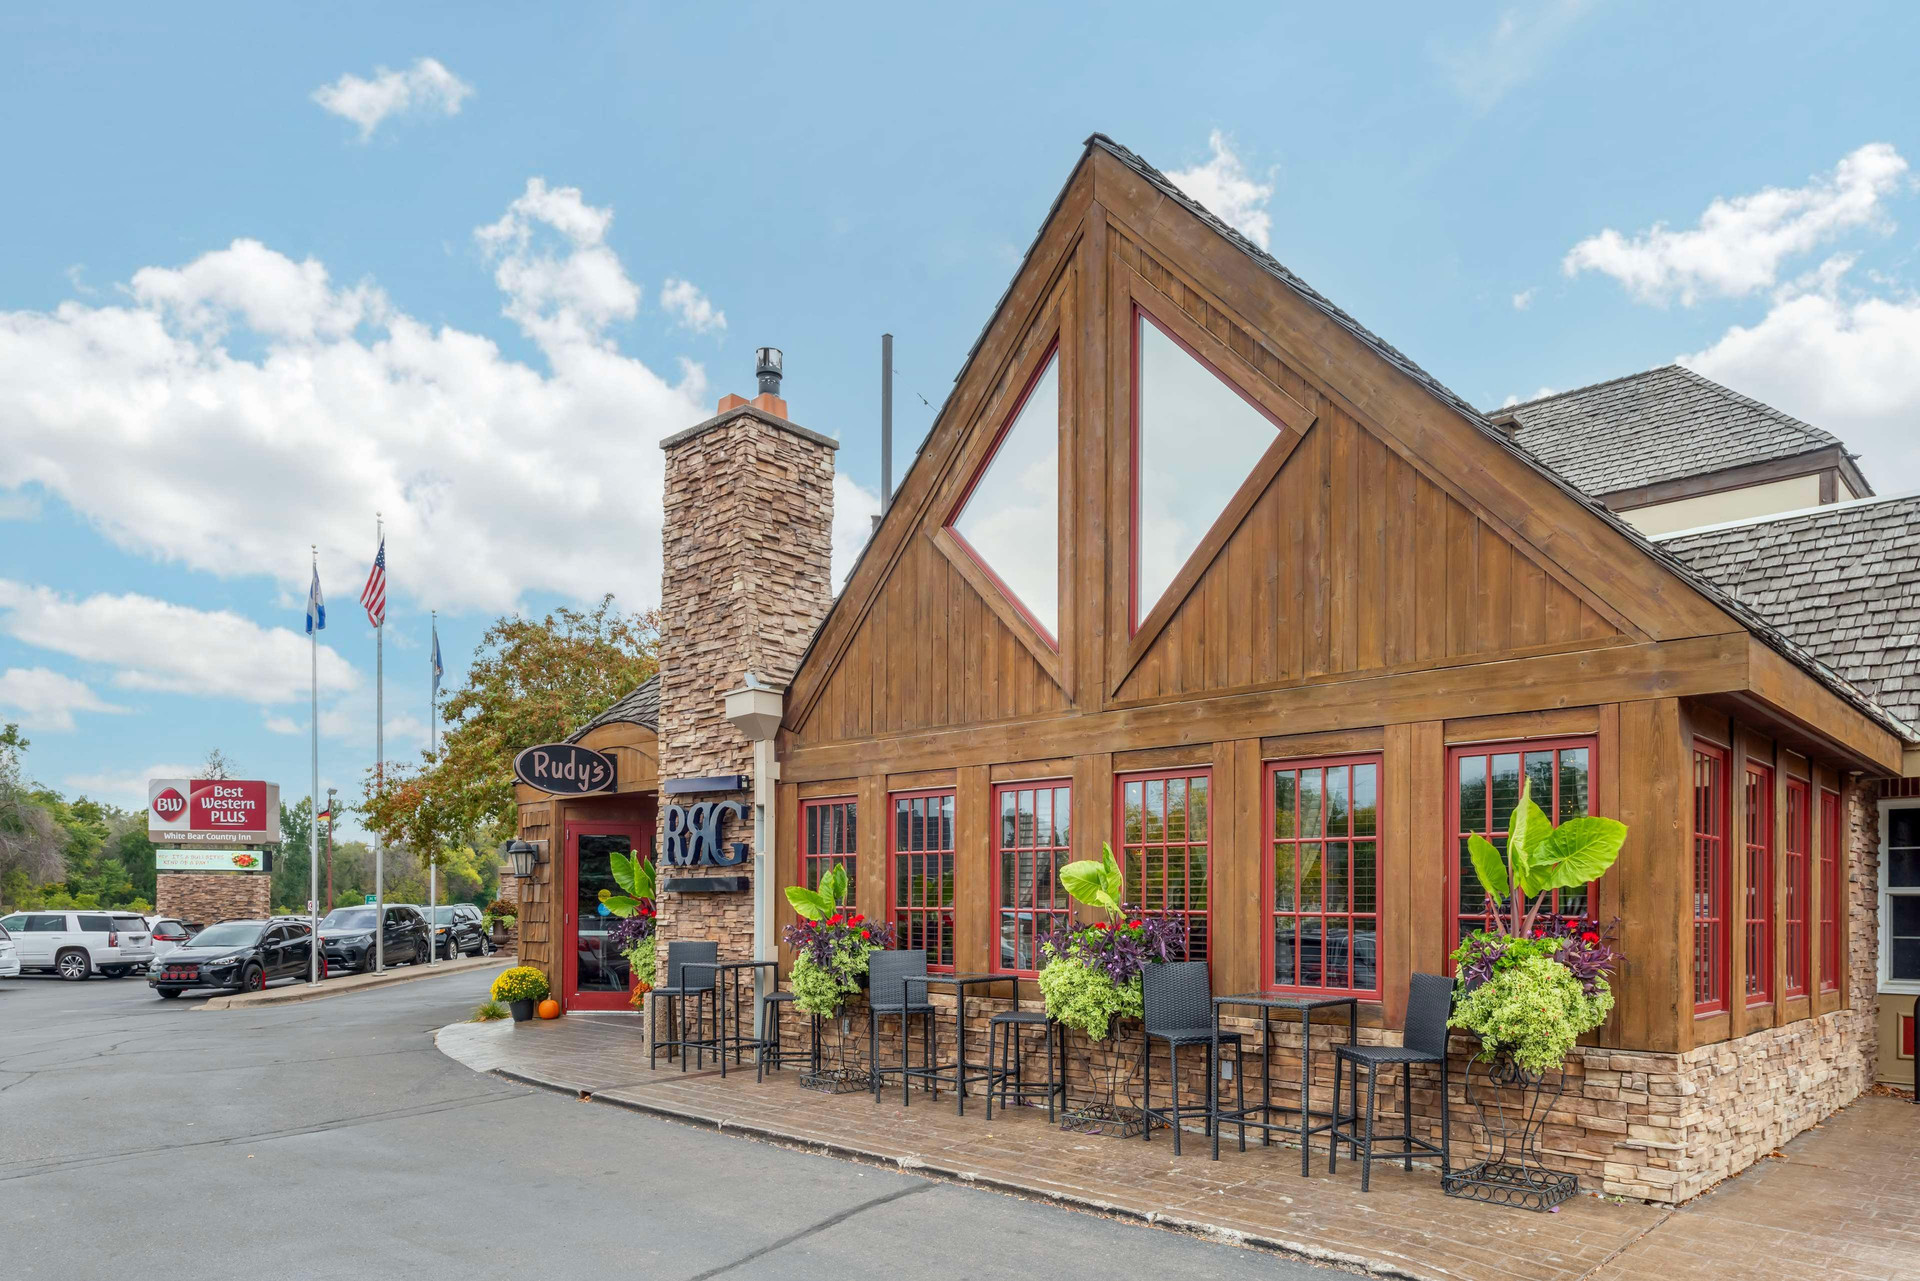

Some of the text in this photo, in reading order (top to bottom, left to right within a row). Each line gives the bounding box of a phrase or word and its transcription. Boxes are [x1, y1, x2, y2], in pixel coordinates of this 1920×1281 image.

[533, 749, 605, 792] Rudy's
[214, 786, 243, 797] Best
[157, 798, 182, 811] BW
[201, 797, 255, 809] Western
[163, 832, 252, 842] White Bear Country Inn
